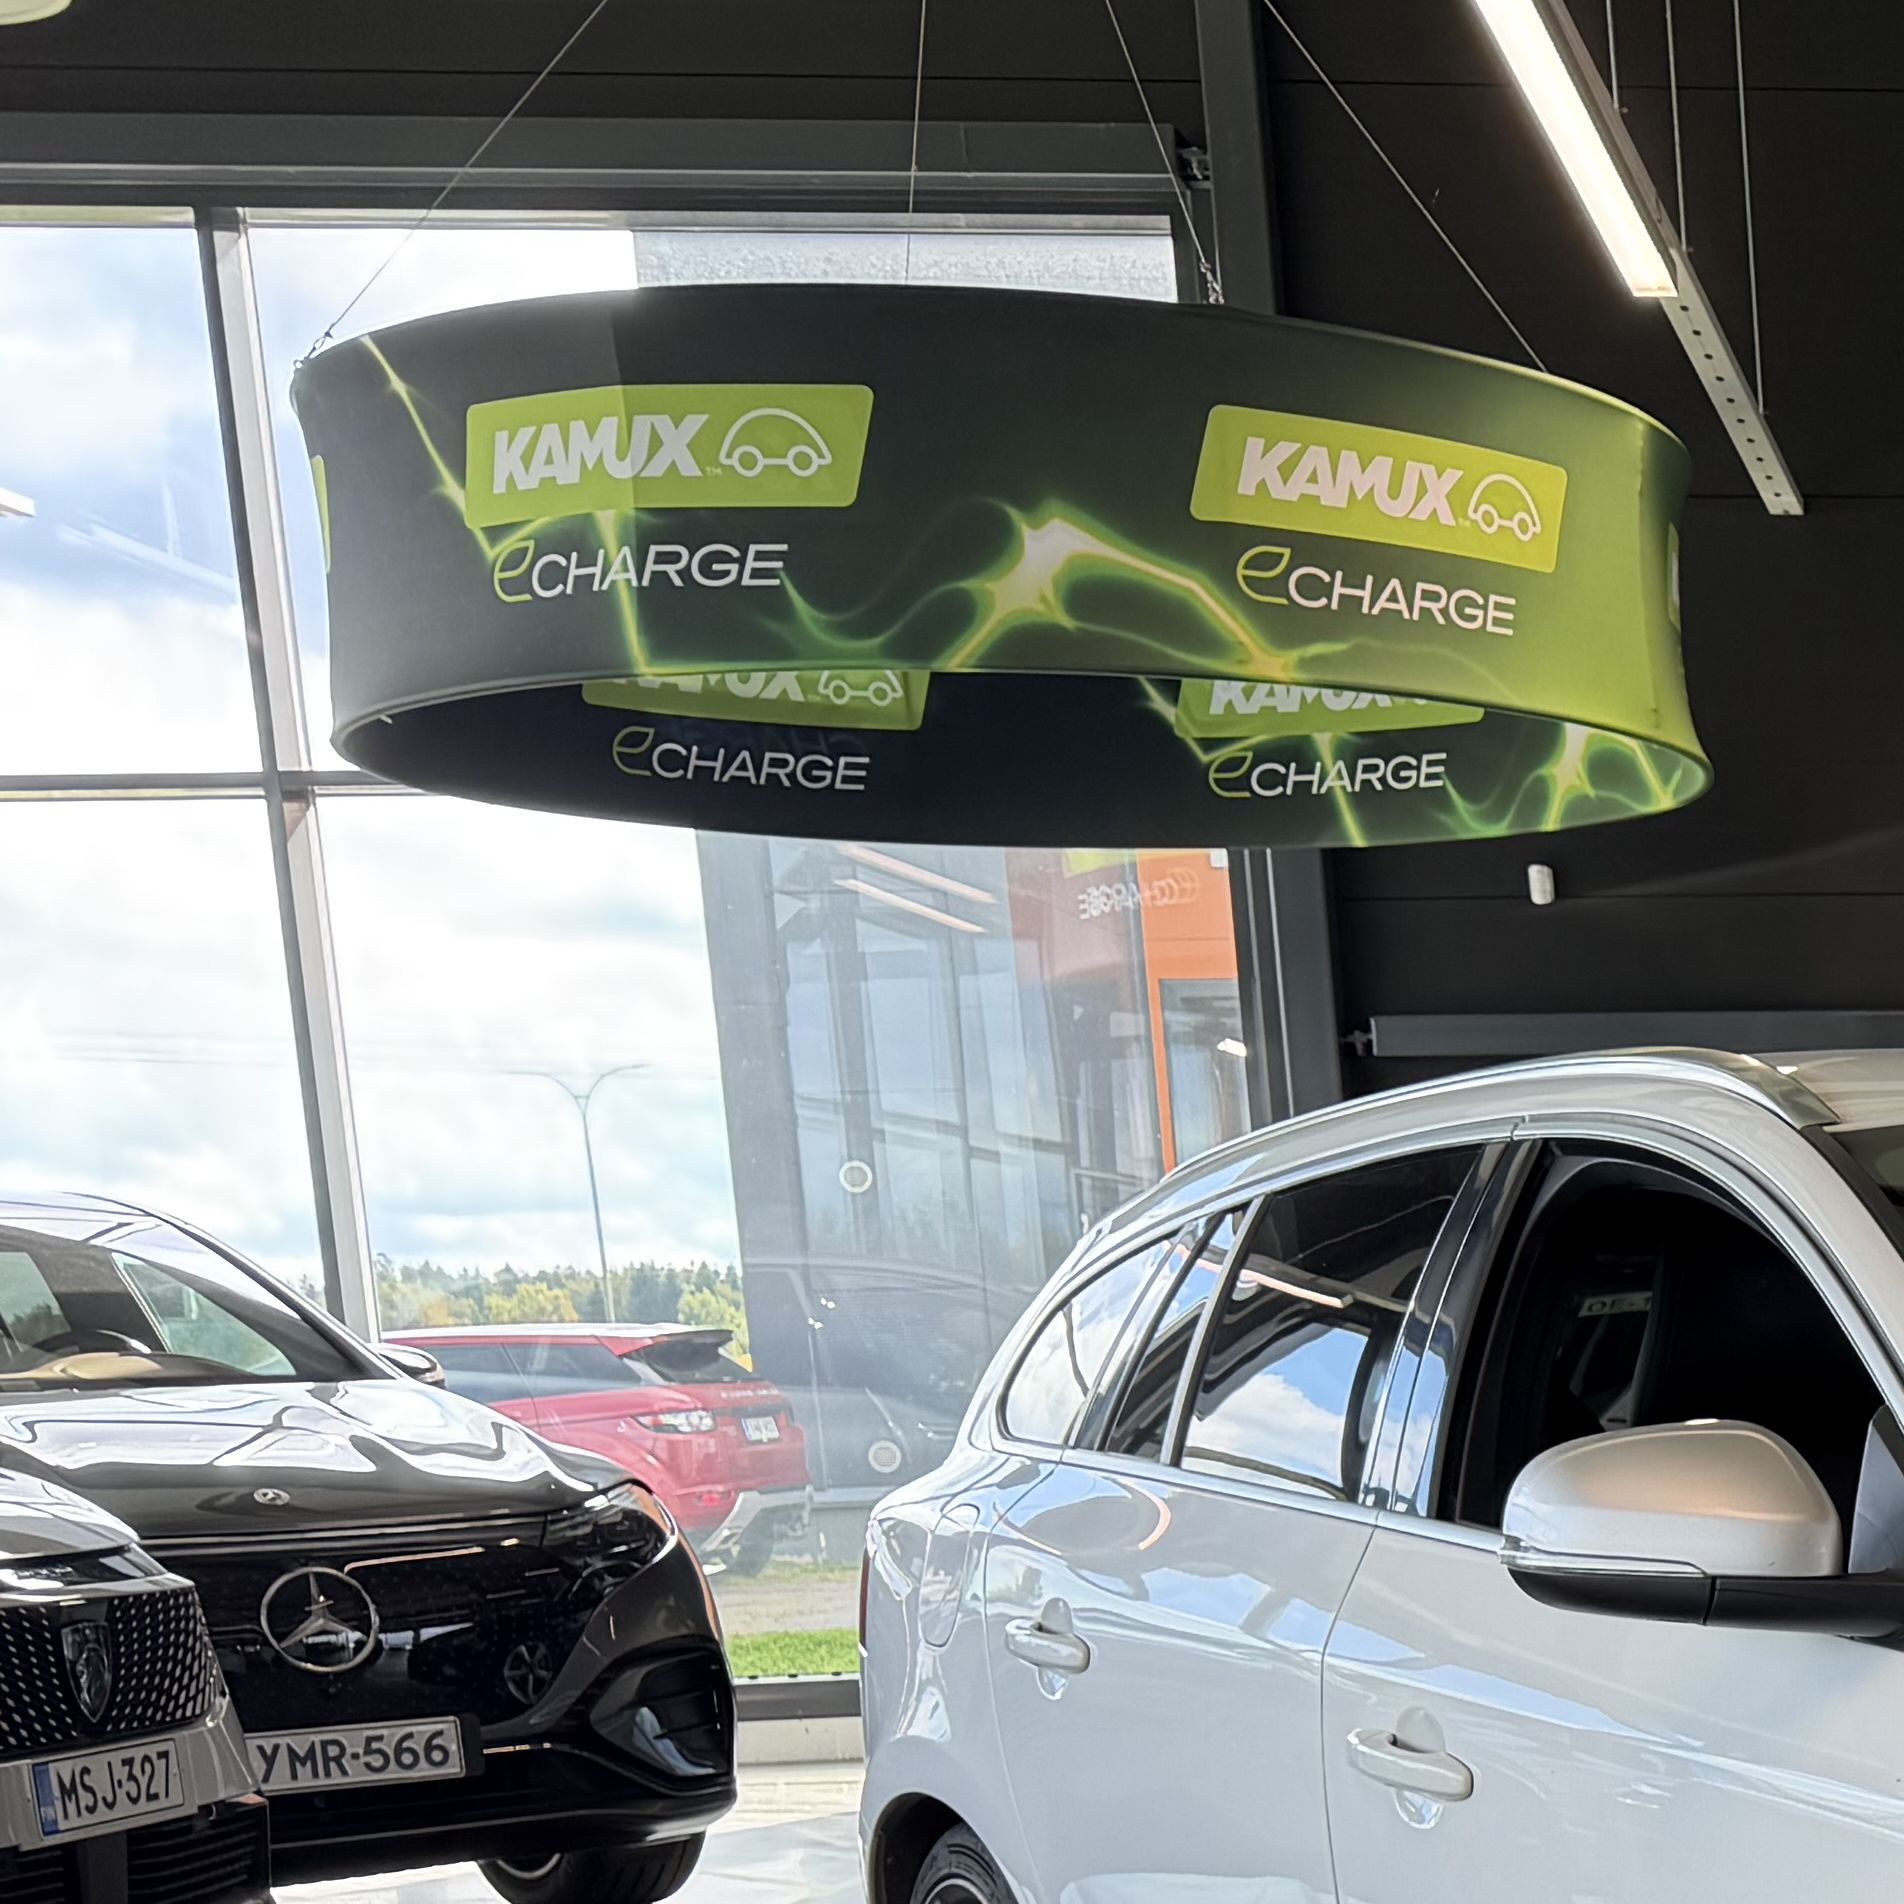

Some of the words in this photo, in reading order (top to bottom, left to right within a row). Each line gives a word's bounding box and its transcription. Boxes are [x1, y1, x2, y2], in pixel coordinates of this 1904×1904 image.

[492, 413, 709, 494] KAMUX
[1237, 436, 1464, 527] KAMUX
[56, 1749, 170, 1821] MSJ-327
[256, 1729, 450, 1784] YMR-566
